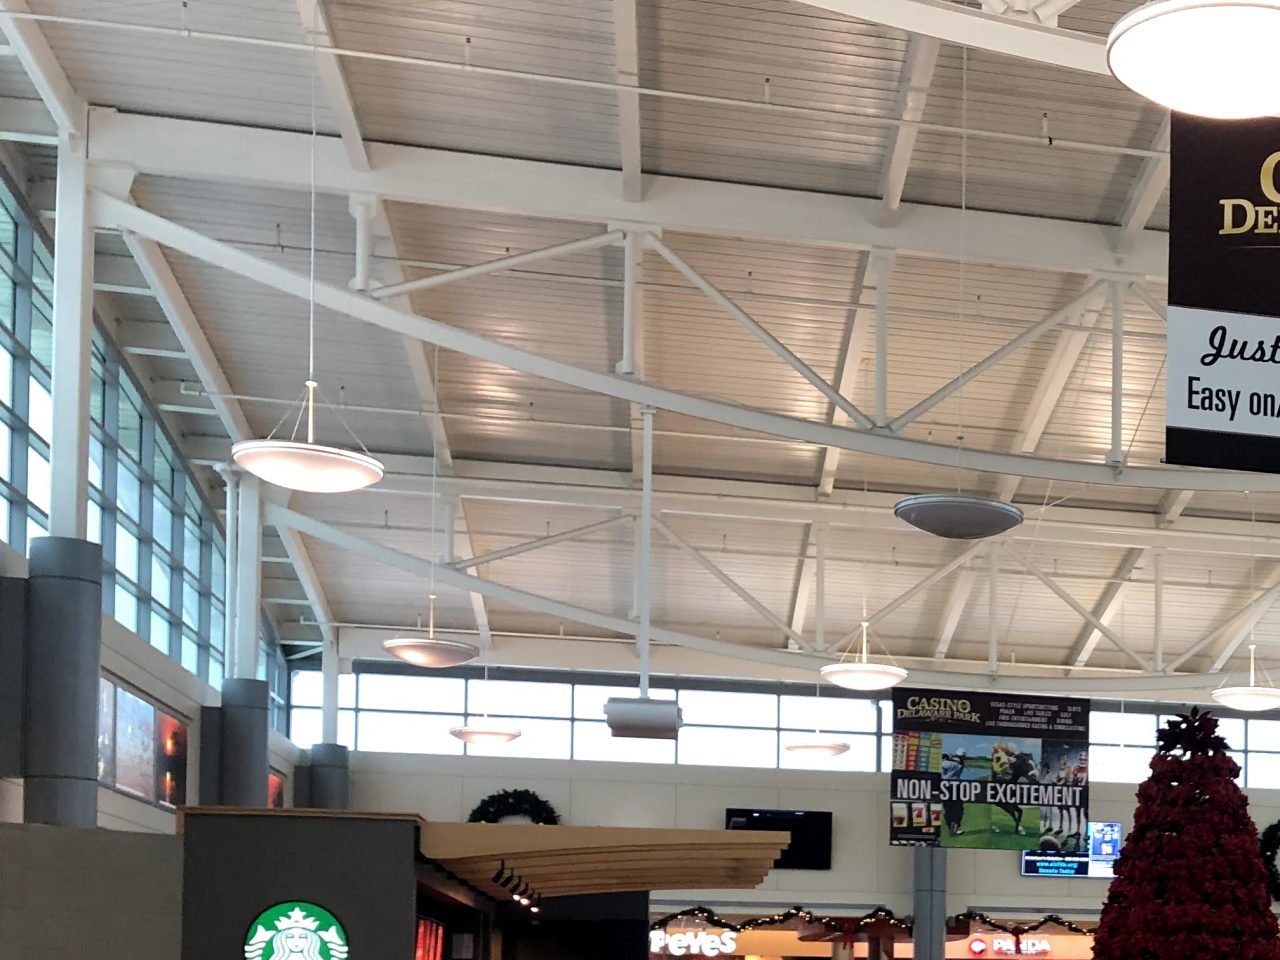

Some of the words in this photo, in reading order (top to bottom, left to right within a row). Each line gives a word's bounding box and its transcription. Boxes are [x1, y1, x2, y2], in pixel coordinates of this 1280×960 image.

[1187, 376, 1240, 421] Easy
[906, 696, 971, 713] CASINO
[897, 708, 952, 719] DELAWARE
[953, 711, 981, 723] PARK
[896, 778, 981, 801] NON-STOP
[986, 783, 1083, 806] EXCITEMENT
[992, 939, 1052, 951] PANDA
